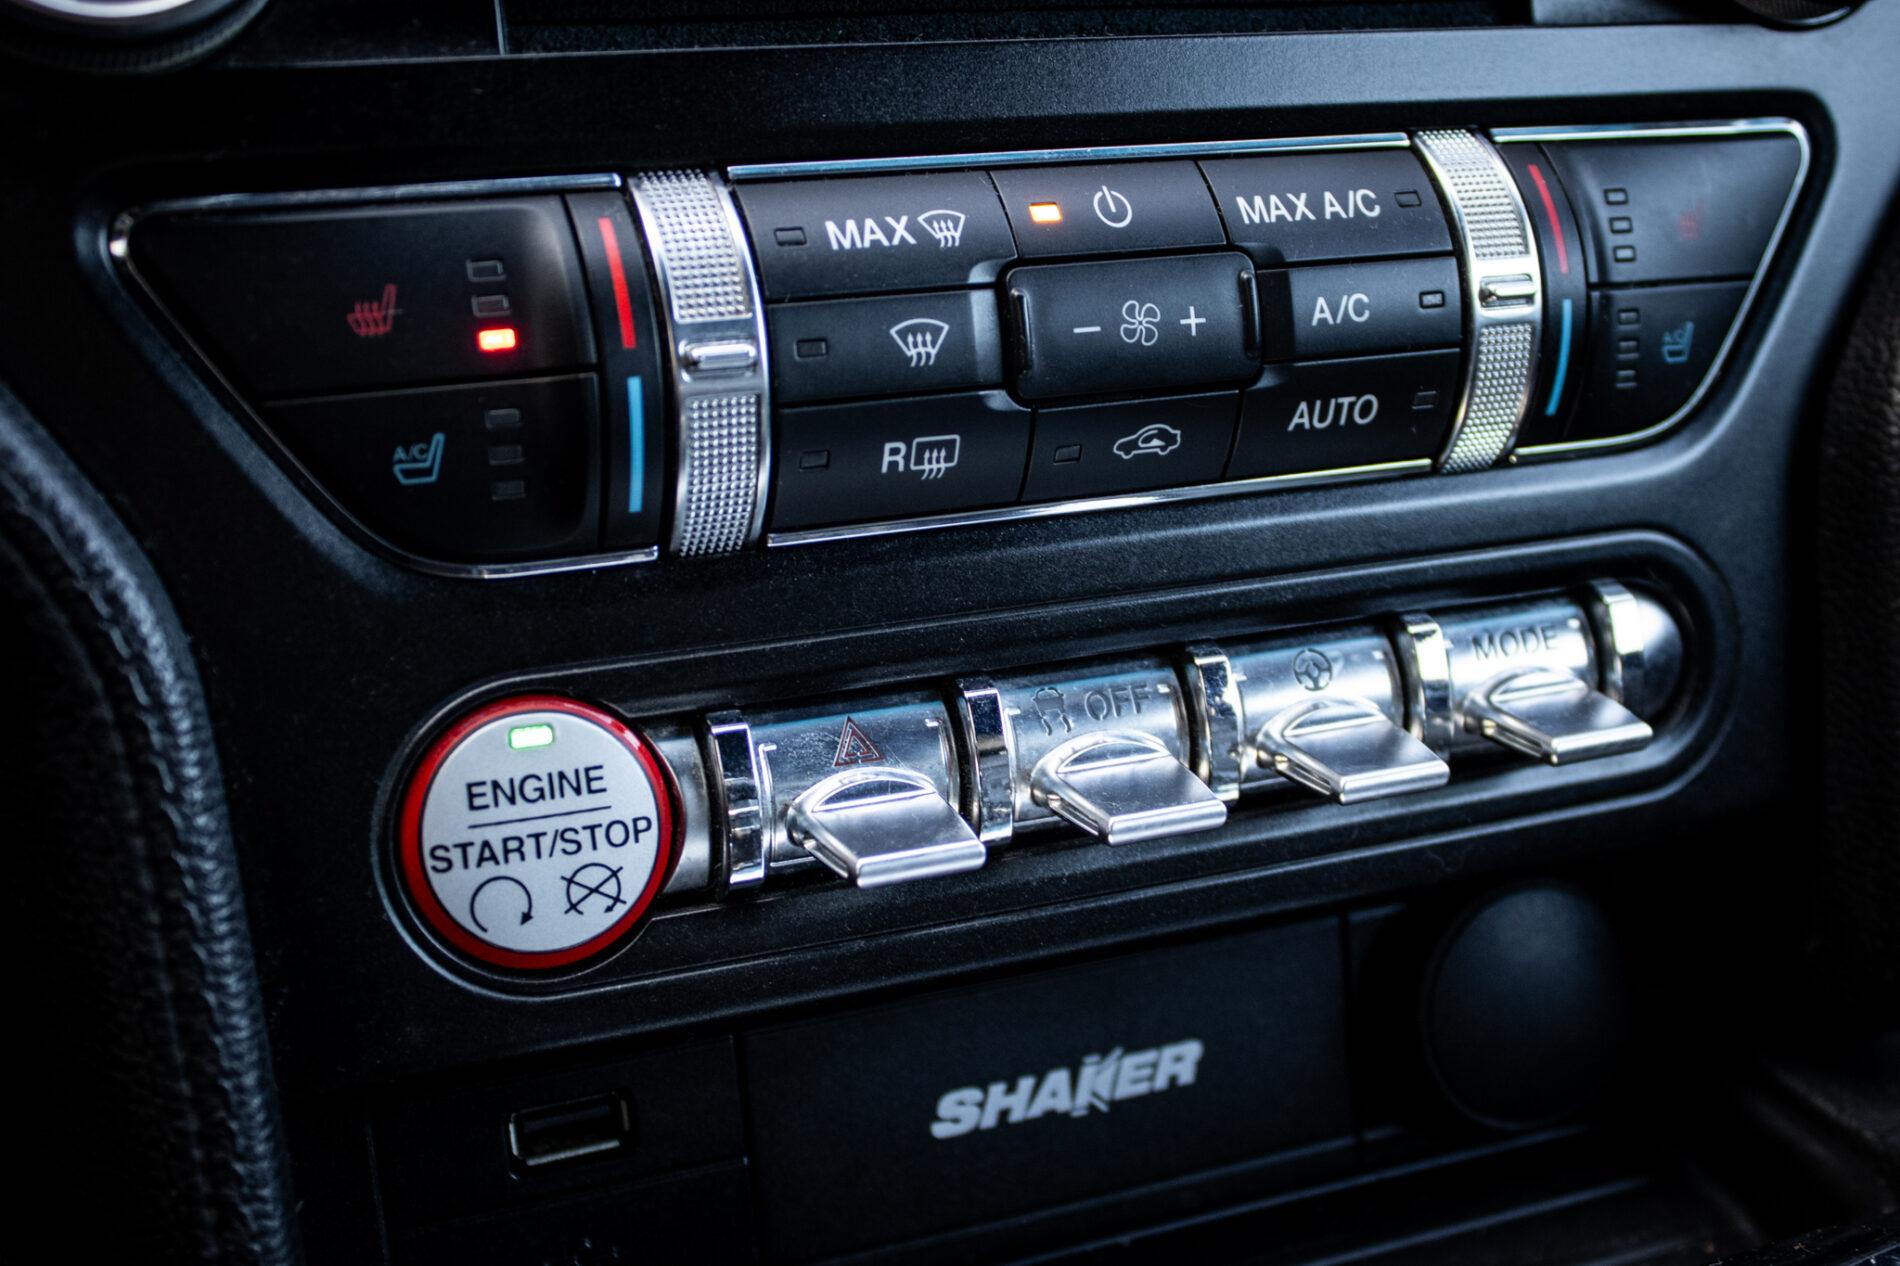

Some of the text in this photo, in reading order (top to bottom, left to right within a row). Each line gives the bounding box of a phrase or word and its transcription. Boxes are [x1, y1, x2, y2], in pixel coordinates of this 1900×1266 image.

[1235, 188, 1381, 225] MAX A/C
[824, 214, 918, 251] MAX
[1311, 292, 1371, 327] A/C
[1287, 393, 1379, 432] AUTO
[881, 441, 907, 474] R
[1471, 624, 1560, 661] MODE
[1084, 683, 1151, 721] OFF
[465, 764, 608, 812] ENGINE
[429, 815, 653, 875] START/STOP
[930, 1037, 1204, 1140] SHAKER
